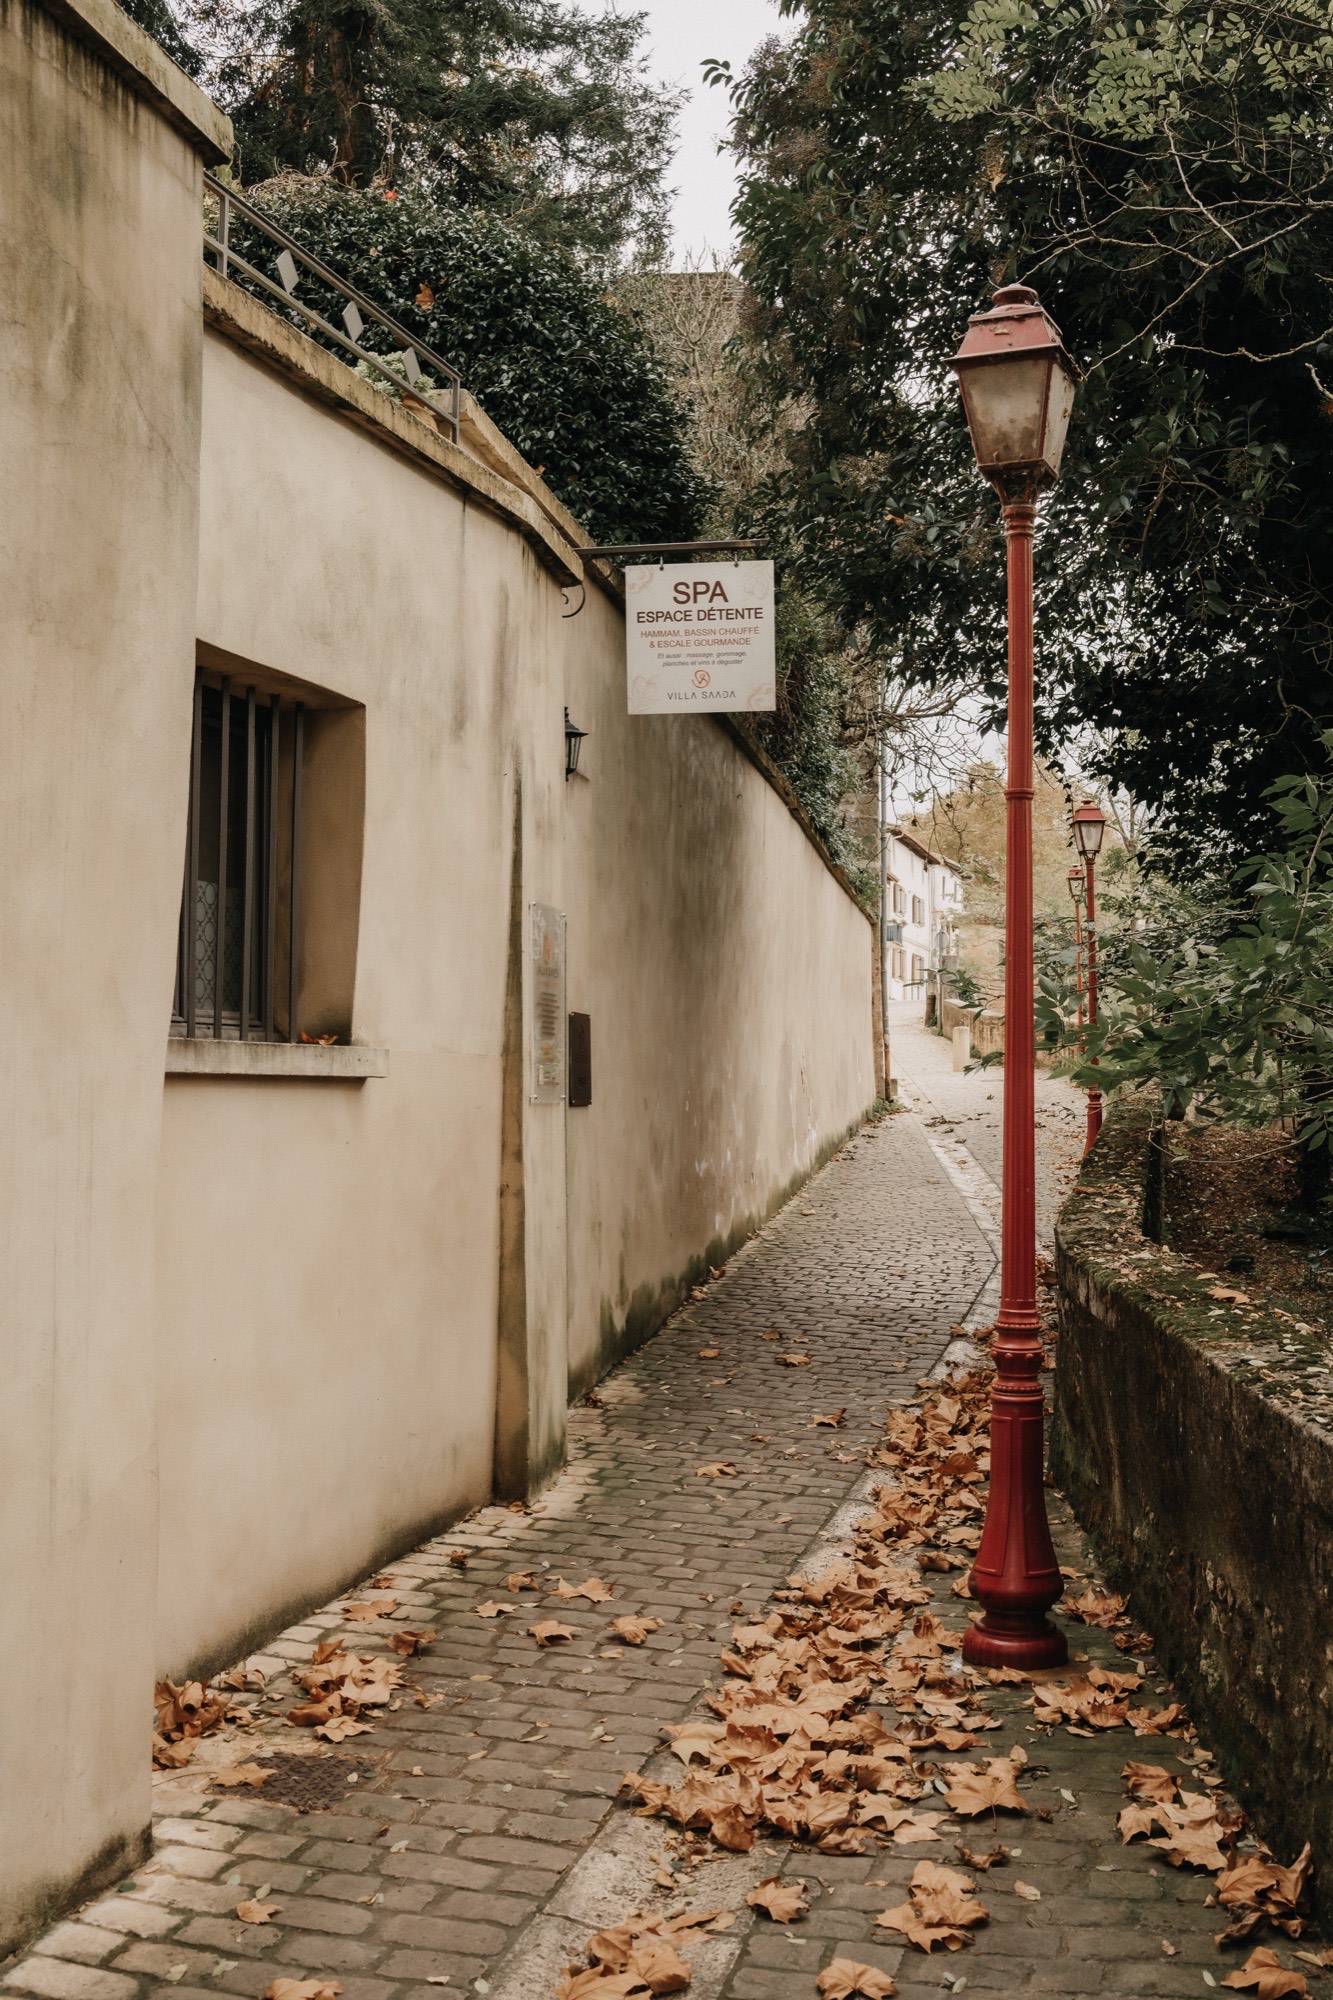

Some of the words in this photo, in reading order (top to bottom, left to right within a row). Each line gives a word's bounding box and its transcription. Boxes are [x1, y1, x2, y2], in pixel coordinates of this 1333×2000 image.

[673, 581, 729, 604] SPA
[637, 610, 693, 623] ESPACE
[698, 607, 763, 621] DÉTENTE
[641, 630, 682, 639] HAMMAM,
[719, 626, 759, 635] CHAUFFÉ
[694, 638, 751, 646] GOURMANDE
